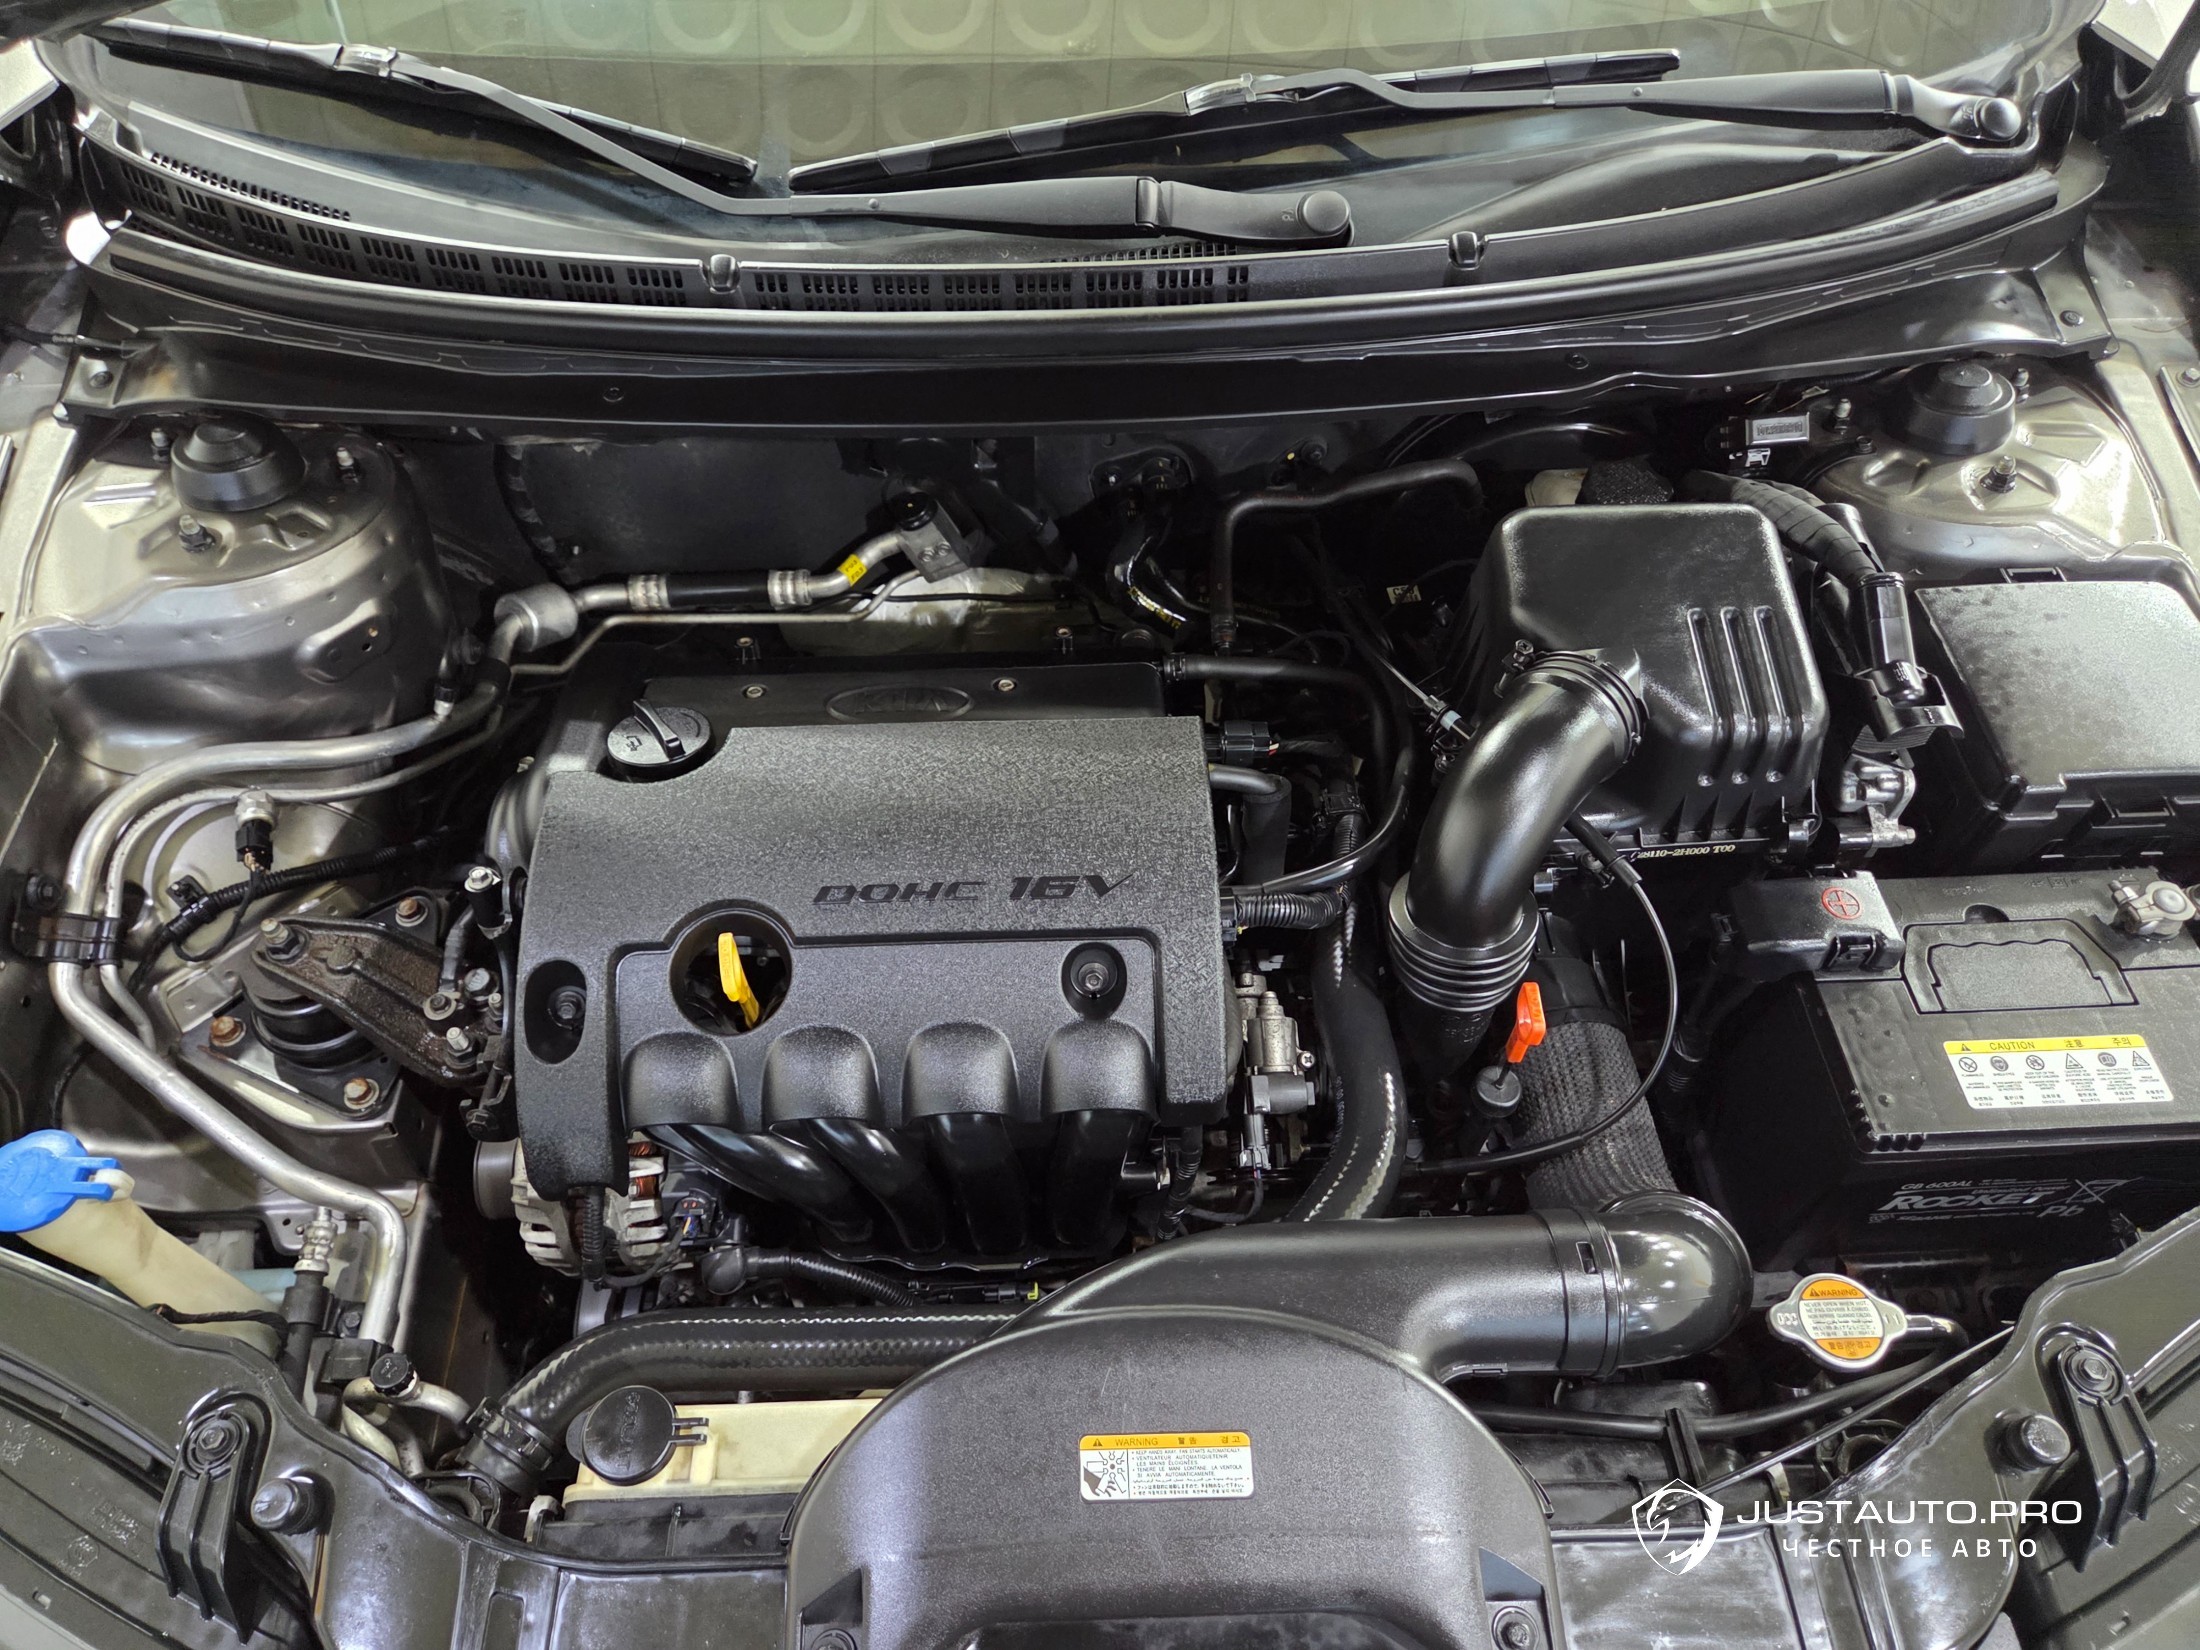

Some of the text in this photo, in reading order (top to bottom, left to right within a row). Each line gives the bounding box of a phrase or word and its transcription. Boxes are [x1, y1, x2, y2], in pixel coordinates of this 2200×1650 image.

[812, 873, 1134, 905] DOHC 16V
[1989, 1041, 2036, 1051] CAUTION
[1901, 1182, 1923, 1190] GB
[1877, 1190, 2058, 1211] ROCKET
[2037, 1204, 2086, 1218] Pb
[1819, 1288, 1858, 1297] WARNING
[1115, 1437, 1159, 1446] WARNING
